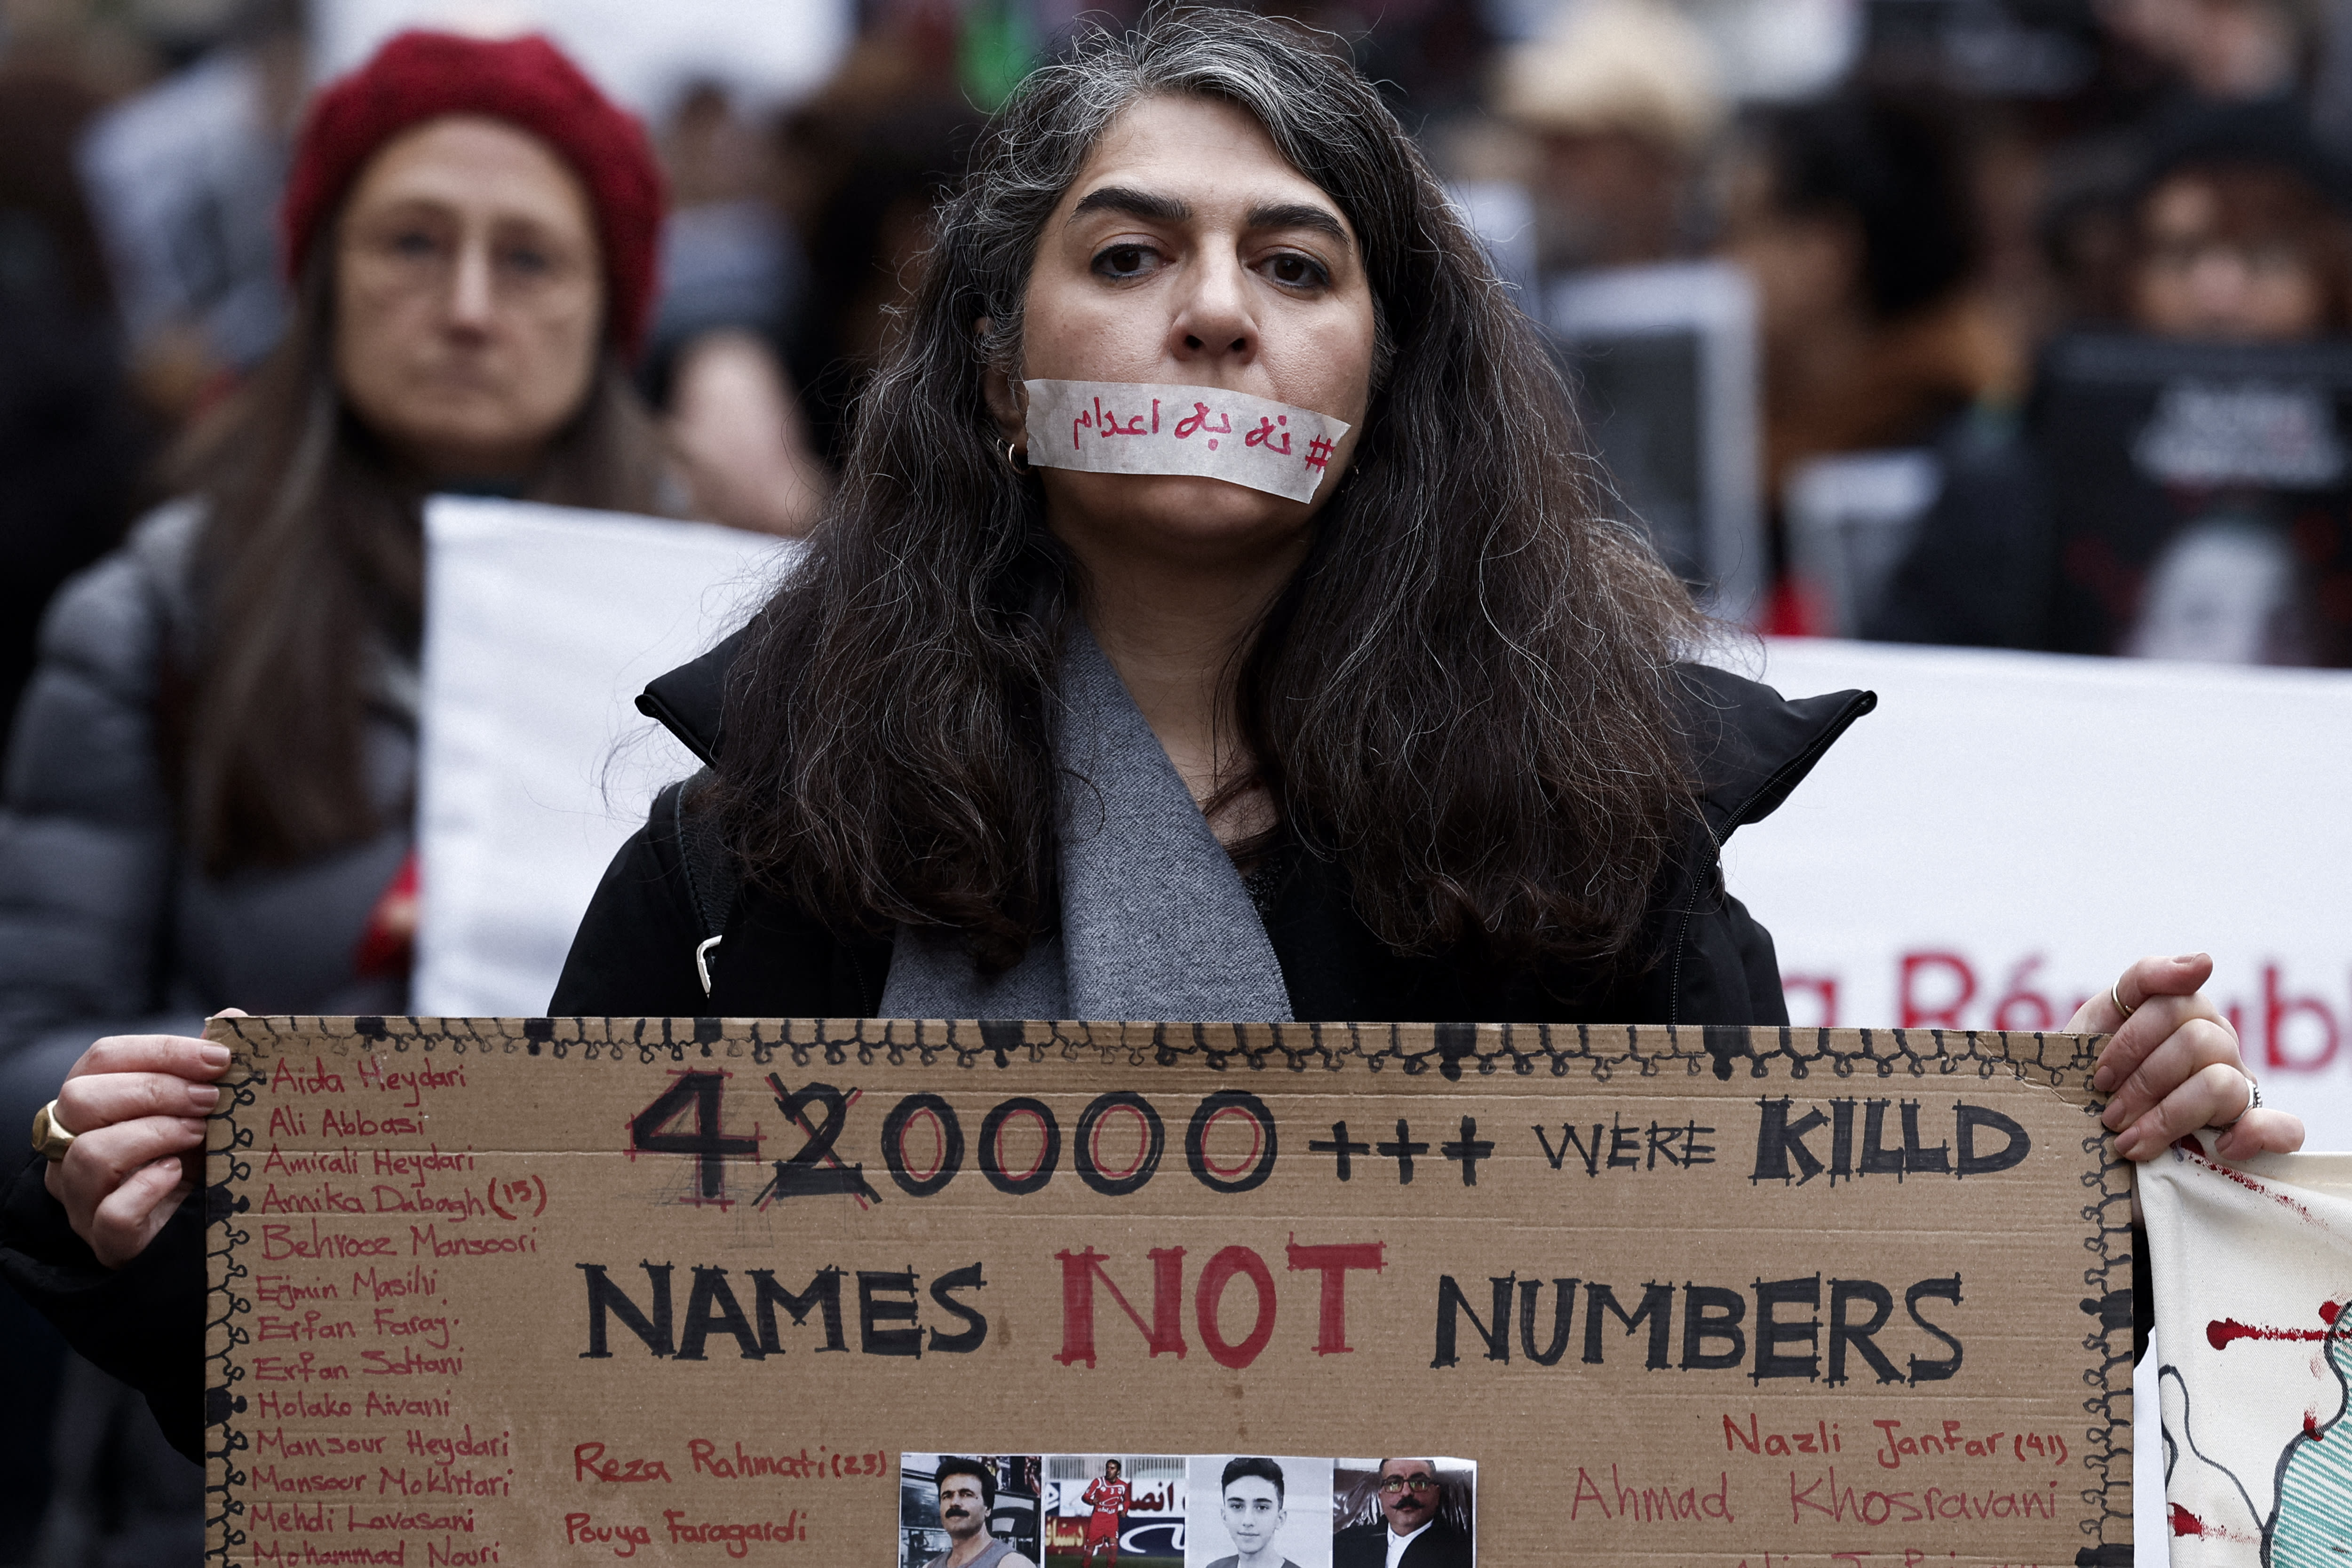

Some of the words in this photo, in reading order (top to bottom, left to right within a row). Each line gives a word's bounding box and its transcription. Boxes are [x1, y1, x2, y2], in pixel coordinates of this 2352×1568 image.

[1073, 396, 1162, 450] اعدام
[1173, 401, 1232, 451] به
[271, 1056, 345, 1095] Aida
[358, 1055, 467, 1108] Heydari
[269, 1104, 306, 1138] Ali
[322, 1108, 423, 1138] Abbasi
[1531, 1112, 1716, 1178] WERE
[1747, 1094, 2032, 1188] KILLD
[263, 1143, 358, 1177] Amirali
[373, 1142, 474, 1188] Heydari
[261, 1217, 397, 1261] Behrooz
[410, 1223, 538, 1258] Mansoori
[257, 1310, 356, 1341] Erfan
[575, 1259, 988, 1361] NAMES
[1052, 1231, 1388, 1369] NOT
[1430, 1270, 1964, 1388] NUMBERS
[253, 1352, 349, 1383] Erfan
[258, 1390, 352, 1420] Holako
[256, 1426, 387, 1458] Mansour
[406, 1424, 509, 1465] Heydari
[1722, 1412, 1841, 1456] Nazli
[378, 1466, 514, 1497] Mokhtari
[574, 1441, 672, 1483] Reza
[688, 1438, 826, 1479] Rahmati
[1571, 1463, 1735, 1523] Ahmad
[1789, 1464, 2058, 1526] Khosravani
[249, 1502, 334, 1532] Mehdi
[348, 1504, 474, 1532] Lavasani
[564, 1513, 651, 1557] Pouya
[253, 1540, 405, 1568] Mohammad
[428, 1535, 500, 1568] Nouri
